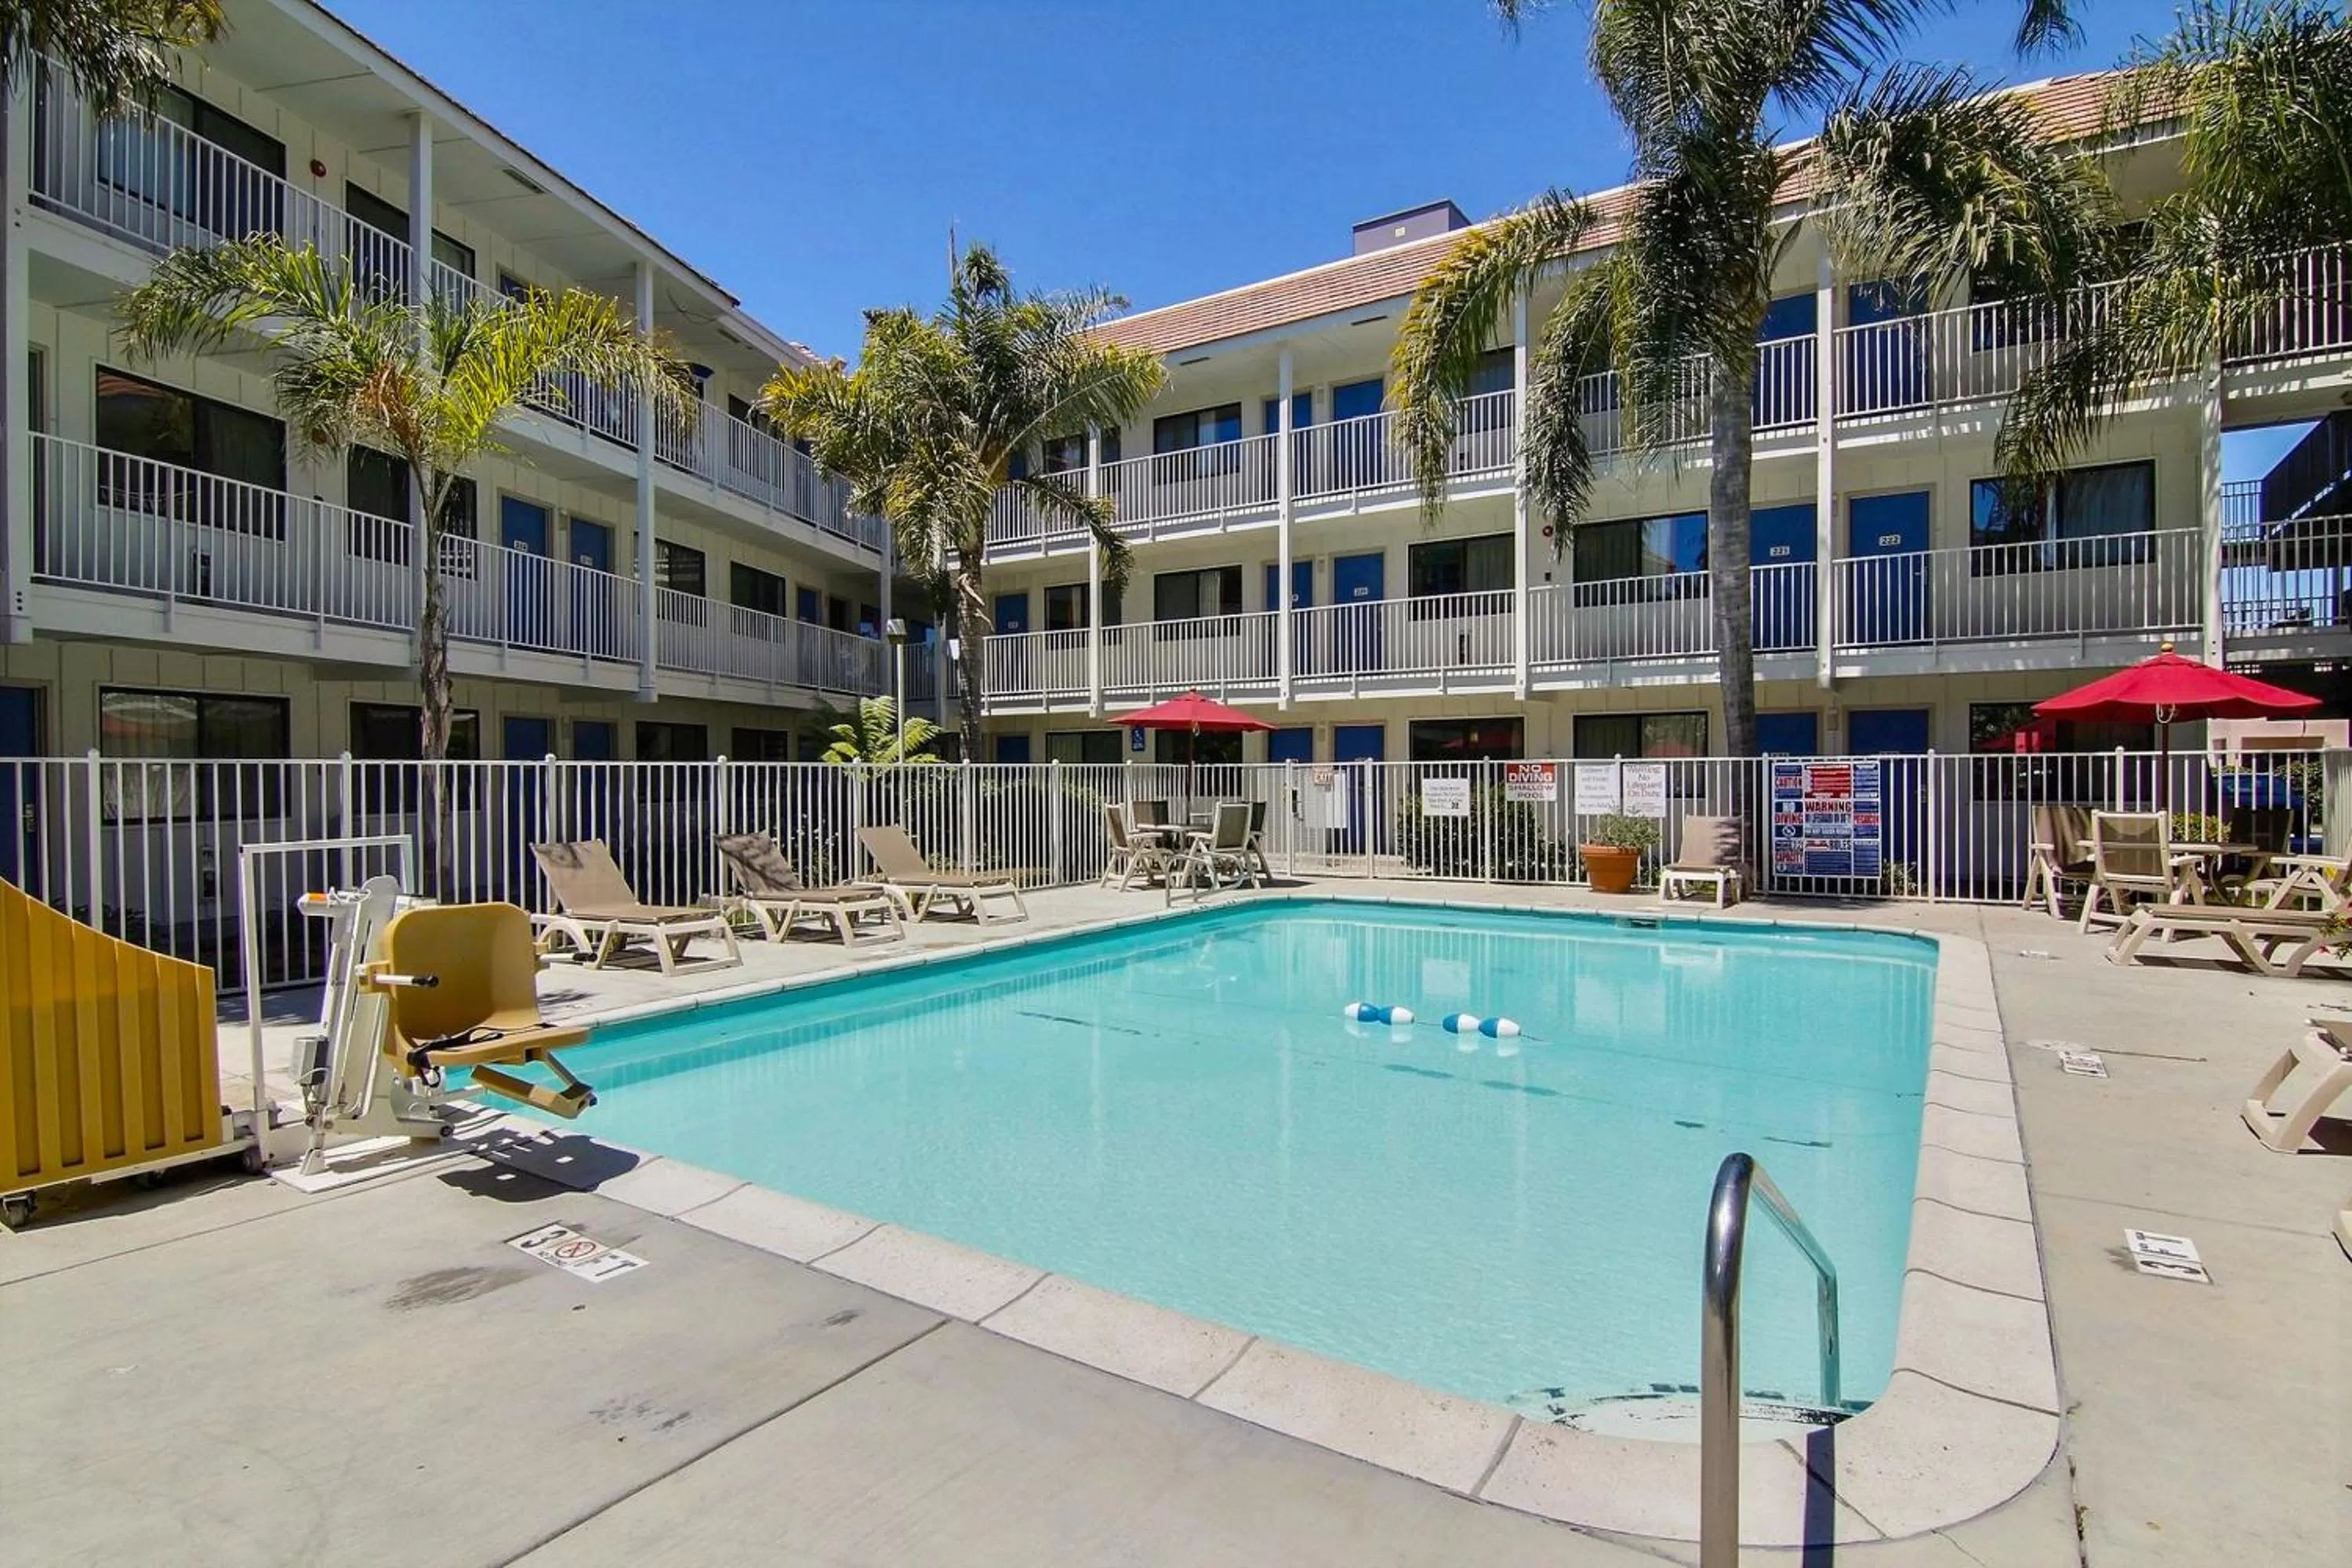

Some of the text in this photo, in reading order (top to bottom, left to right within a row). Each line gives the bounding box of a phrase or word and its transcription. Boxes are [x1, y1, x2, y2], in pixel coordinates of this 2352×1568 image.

[1508, 772, 1552, 782] DIVING
[1774, 777, 1802, 788] CAUTION
[1806, 801, 1851, 812] WARNING
[1774, 814, 1802, 824] DIVING
[1775, 851, 1802, 862] CAPACITY
[520, 1230, 568, 1249] 3
